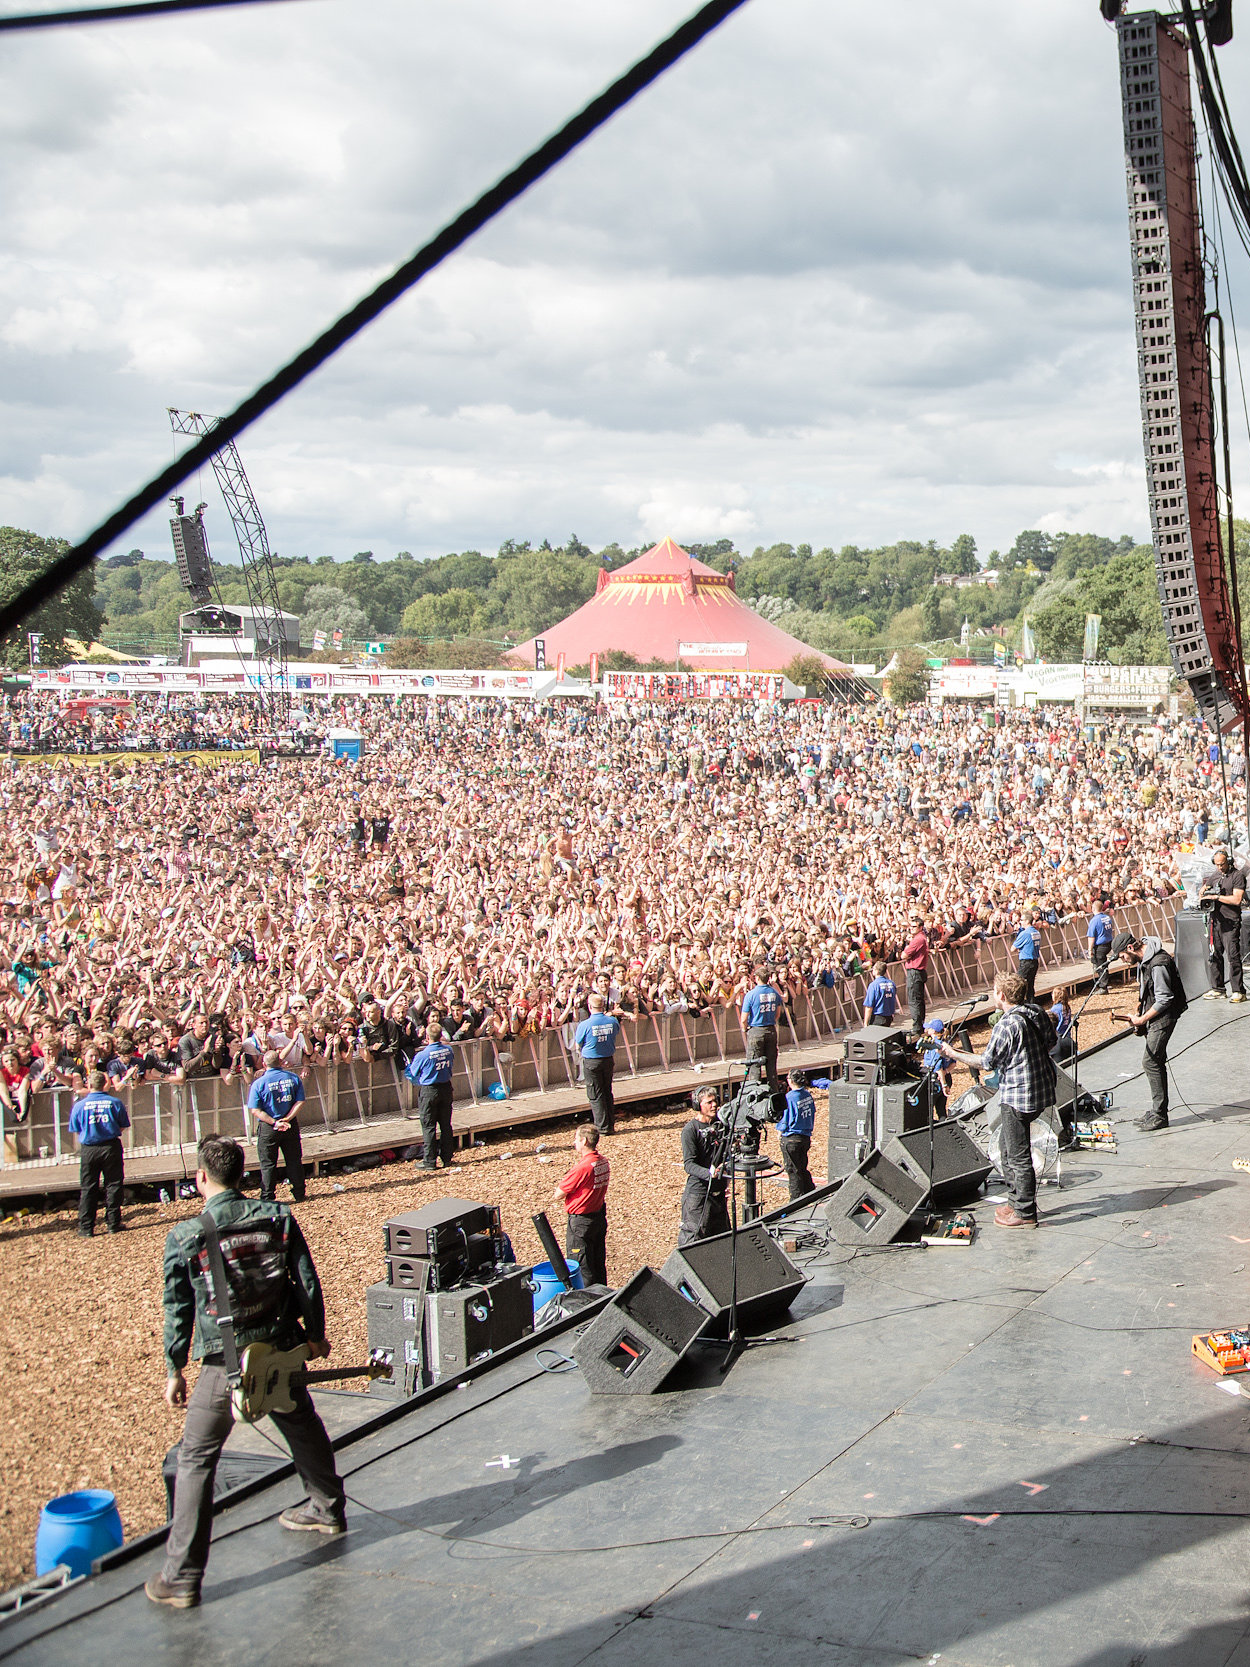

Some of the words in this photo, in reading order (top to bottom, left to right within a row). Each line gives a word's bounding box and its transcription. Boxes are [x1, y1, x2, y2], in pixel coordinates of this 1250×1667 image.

[537, 641, 545, 669] BAR
[1028, 666, 1056, 679] VEGAN
[1039, 673, 1081, 686] VEGETARIAN
[759, 1003, 776, 1013] 226
[435, 1060, 450, 1071] 271
[276, 1094, 293, 1103] 148
[750, 1233, 773, 1262] MB4
